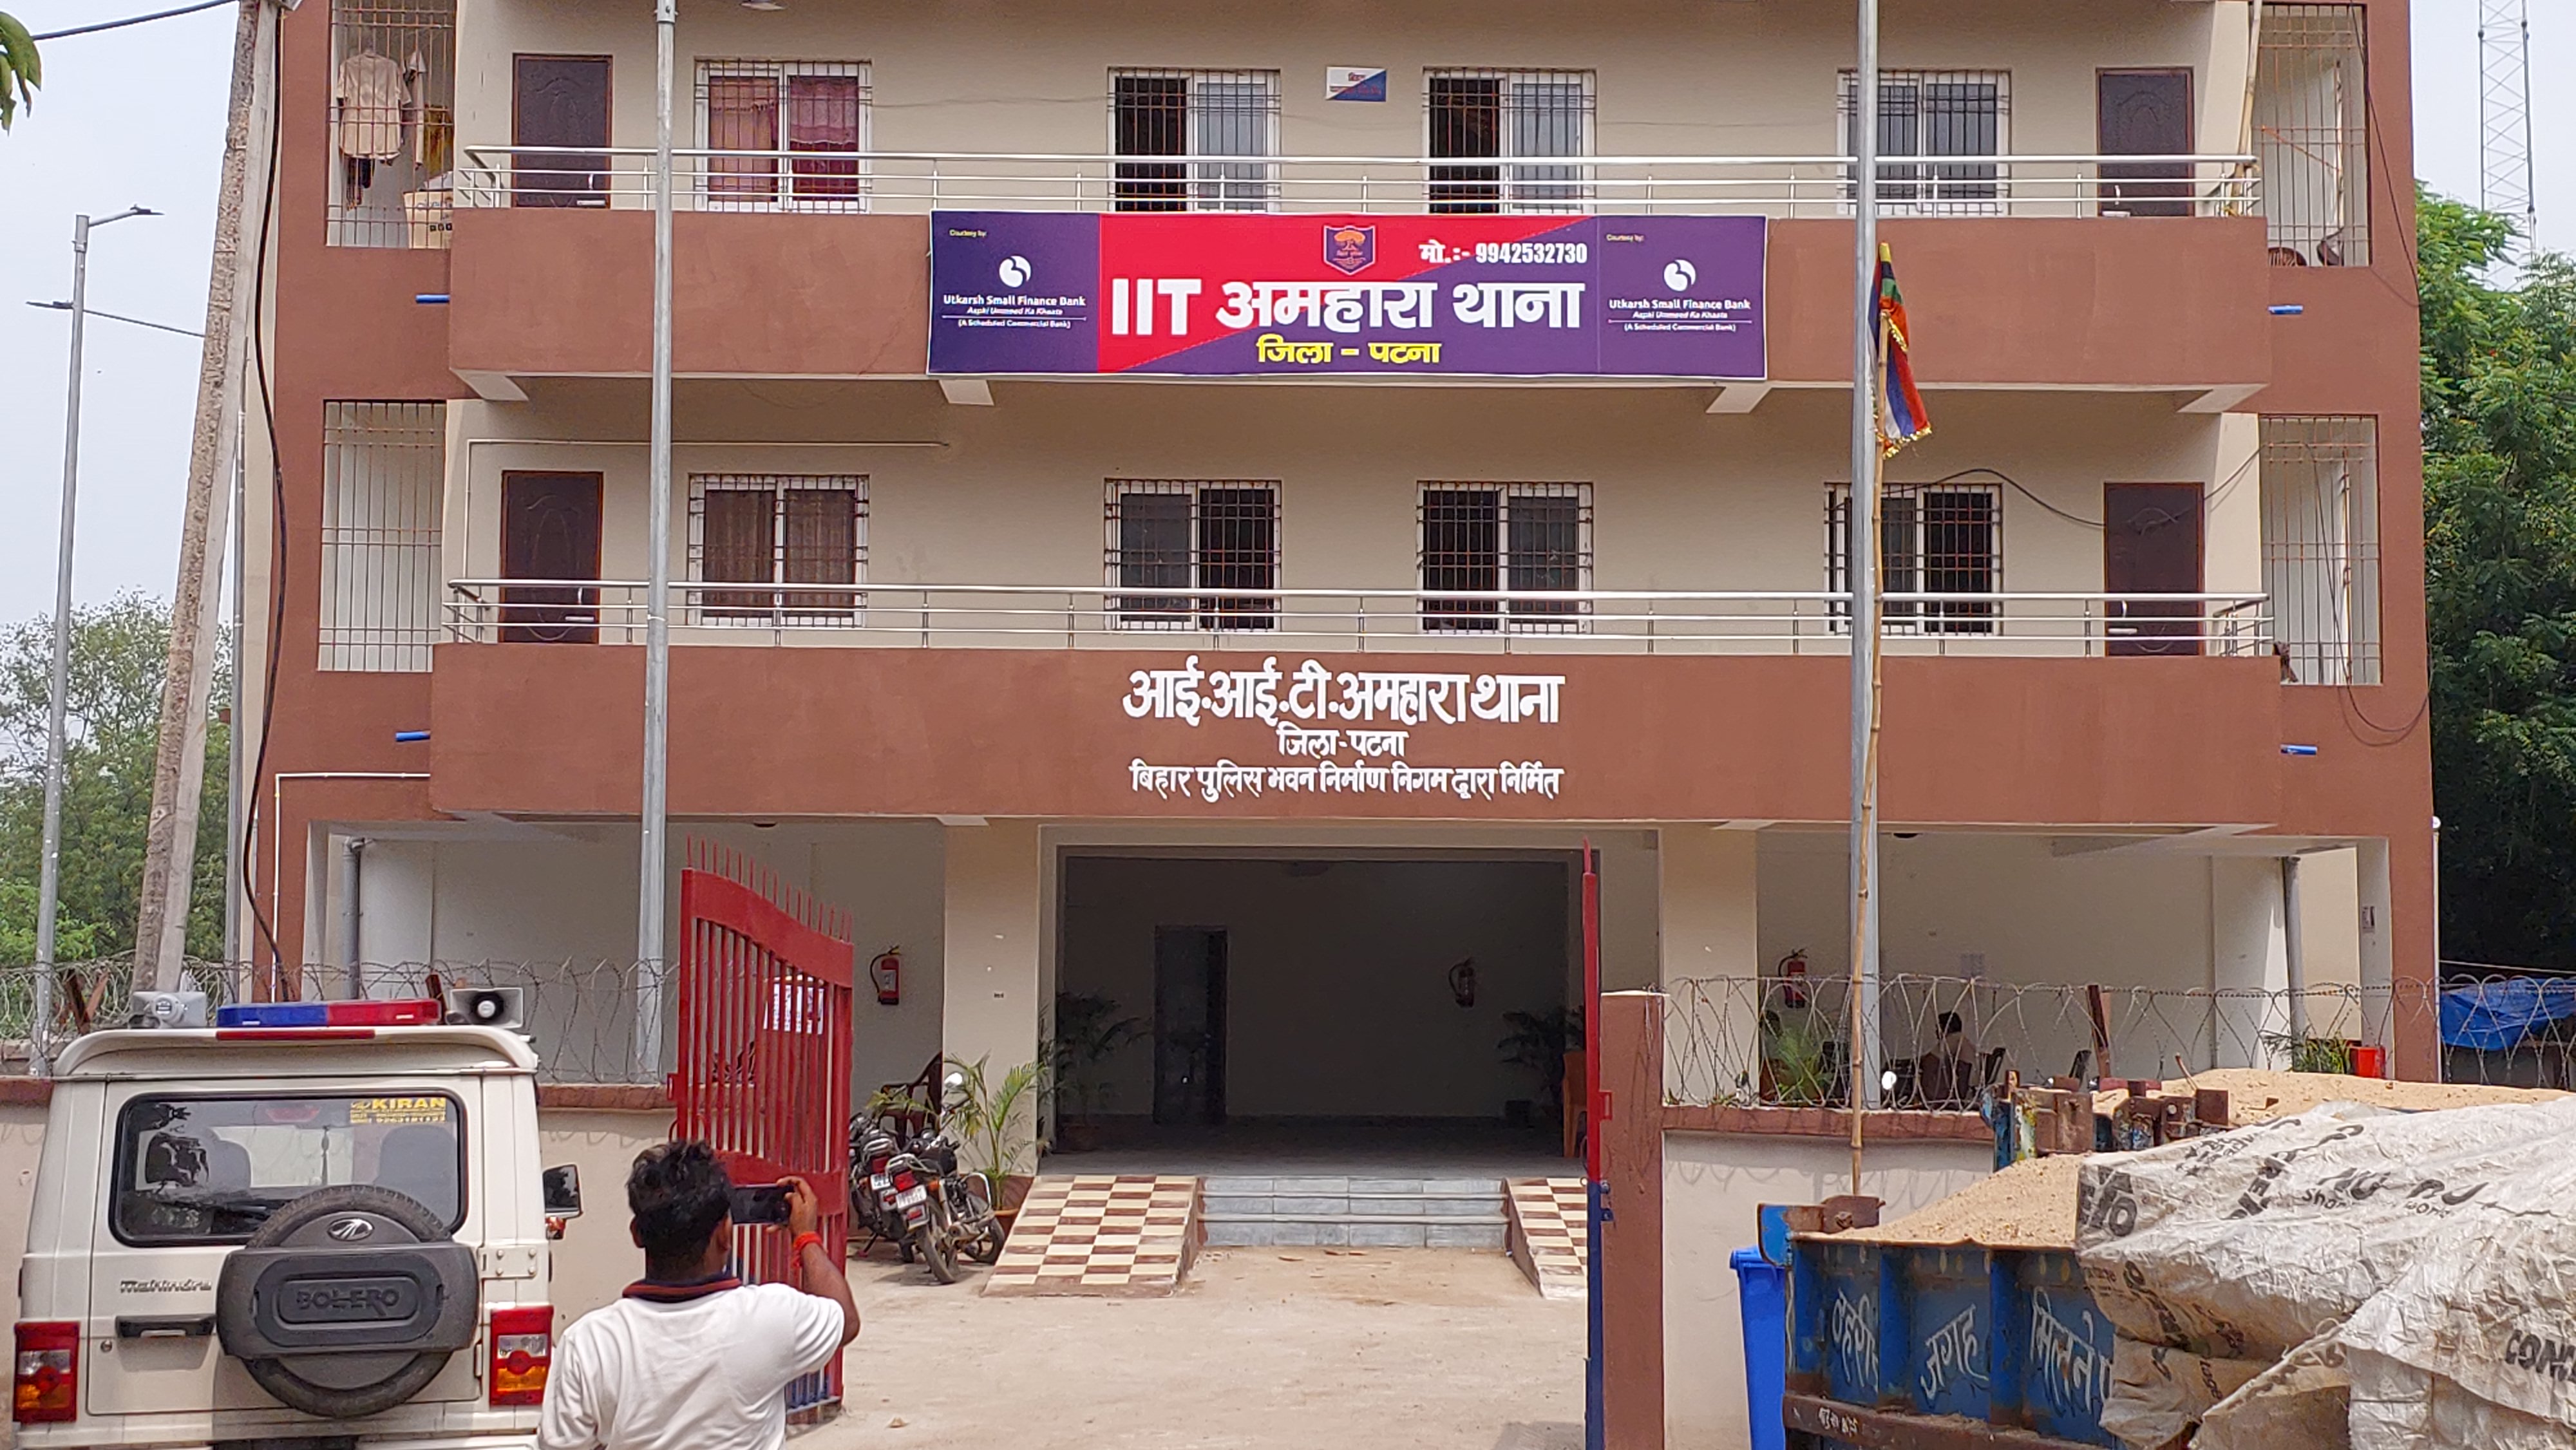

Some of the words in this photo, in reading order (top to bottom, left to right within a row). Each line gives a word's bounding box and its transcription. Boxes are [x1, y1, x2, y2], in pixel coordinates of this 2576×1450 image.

[1475, 242, 1587, 264] 9942532730
[942, 294, 985, 306] Utkarsh
[986, 296, 1016, 306] Small
[1017, 296, 1057, 306] Finance
[1059, 296, 1086, 307] Bank
[1112, 278, 1202, 335] IIT
[1216, 281, 1439, 334] अमहारा
[1453, 282, 1585, 328] थाना
[1609, 299, 1651, 309] Utkarsh
[1651, 299, 1681, 309] Small
[1683, 299, 1722, 310] Finance
[1724, 300, 1751, 310] Bank
[1256, 333, 1332, 362] जिला
[1370, 344, 1441, 362] पटना
[1470, 673, 1566, 724] थाना
[1128, 758, 1195, 799] बिहार
[1195, 758, 1267, 803] पुलिस
[1267, 766, 1320, 793] भवन
[1318, 758, 1391, 793] निर्माण
[1390, 760, 1454, 793] निगम
[1452, 766, 1499, 800] द्वारा
[1499, 758, 1565, 800] निर्मित
[372, 1097, 446, 1109] KIRAN
[296, 1288, 400, 1316] BOLERO
